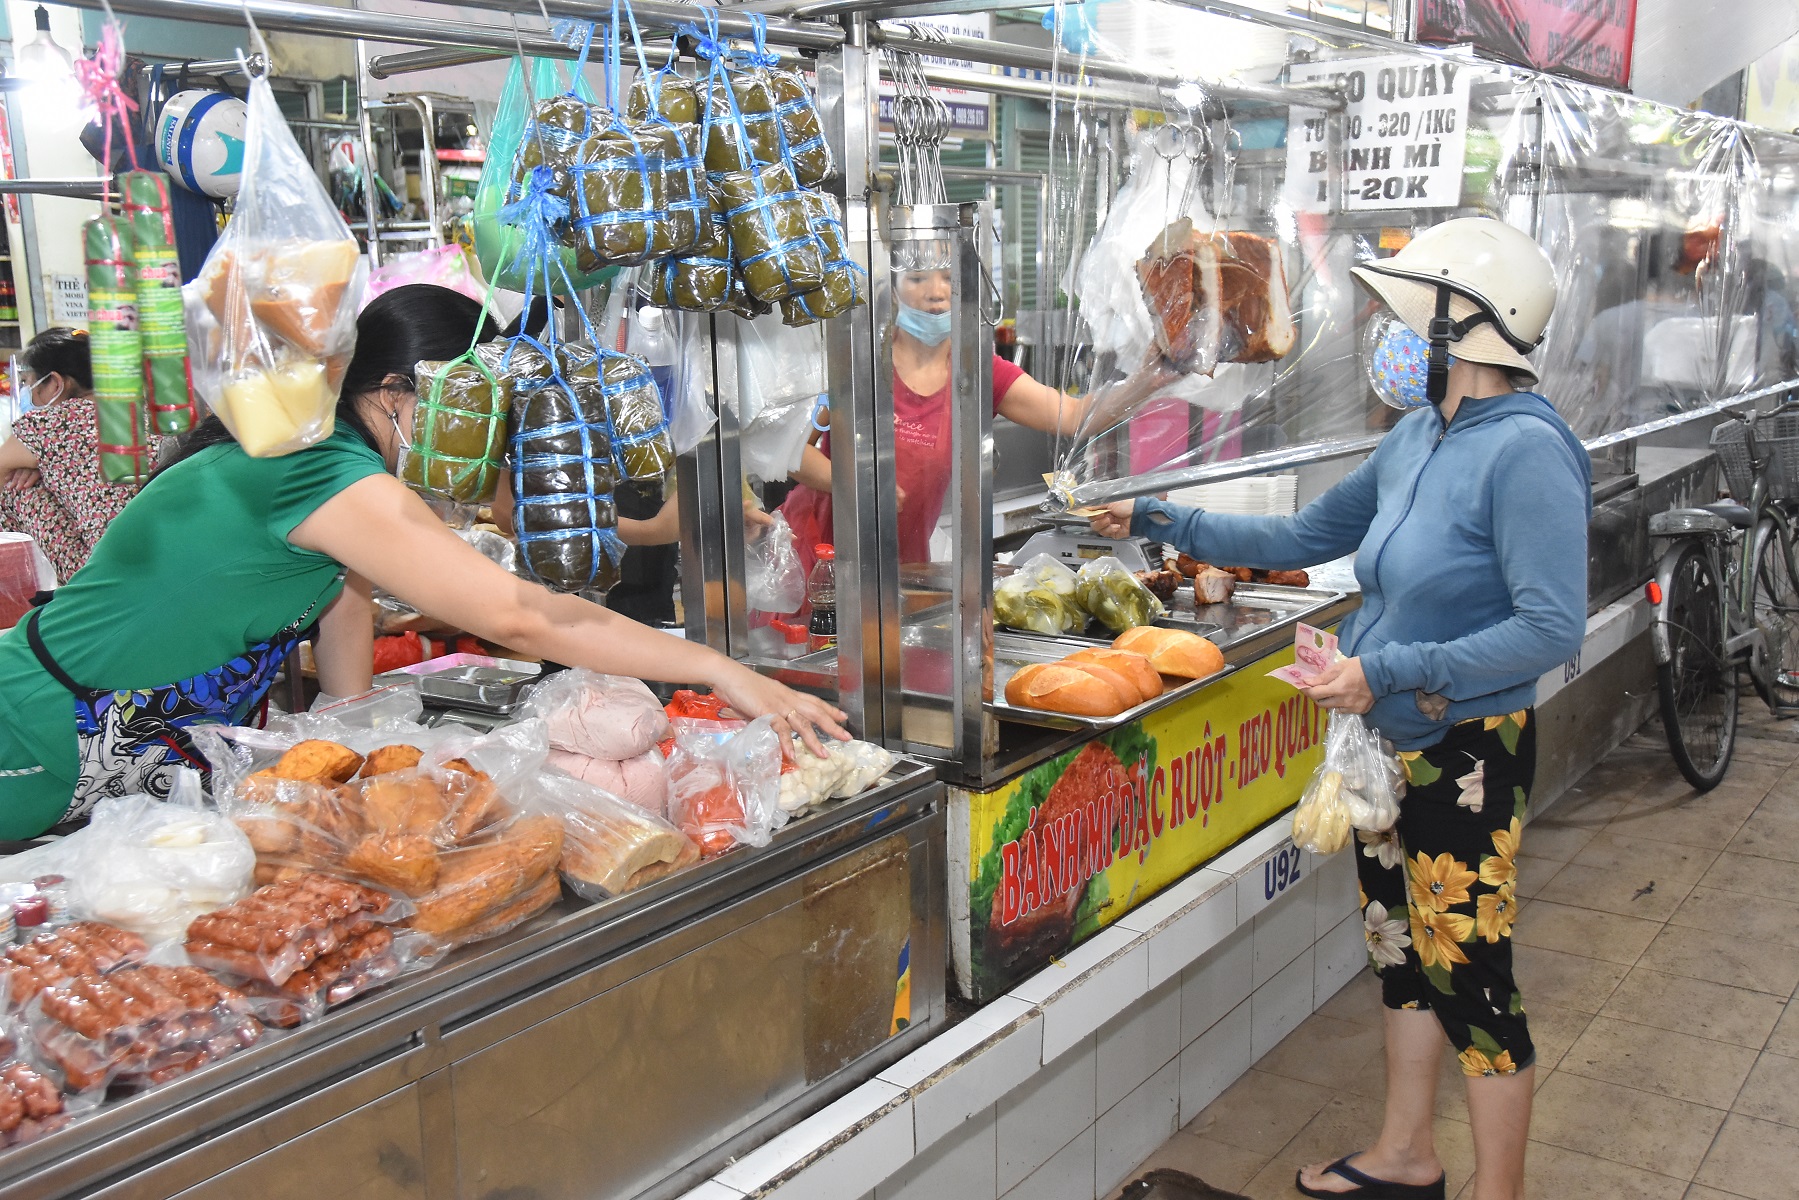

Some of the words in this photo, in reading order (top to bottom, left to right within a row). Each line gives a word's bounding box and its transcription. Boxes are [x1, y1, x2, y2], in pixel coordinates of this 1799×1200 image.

[1377, 63, 1459, 103] QUAY
[1378, 111, 1411, 138] 320
[1308, 146, 1393, 174] BNH
[1404, 137, 1442, 169] MÌ
[1316, 176, 1430, 203] 1-20K
[55, 277, 80, 291] THẺ
[65, 301, 84, 309] VINA
[1001, 806, 1083, 927] BÁNH
[1085, 768, 1115, 882] MÌ
[1118, 750, 1166, 866] ĐẶC
[1169, 720, 1227, 830] RUỘT
[1237, 708, 1272, 791] HEO
[1263, 847, 1302, 901] U92
